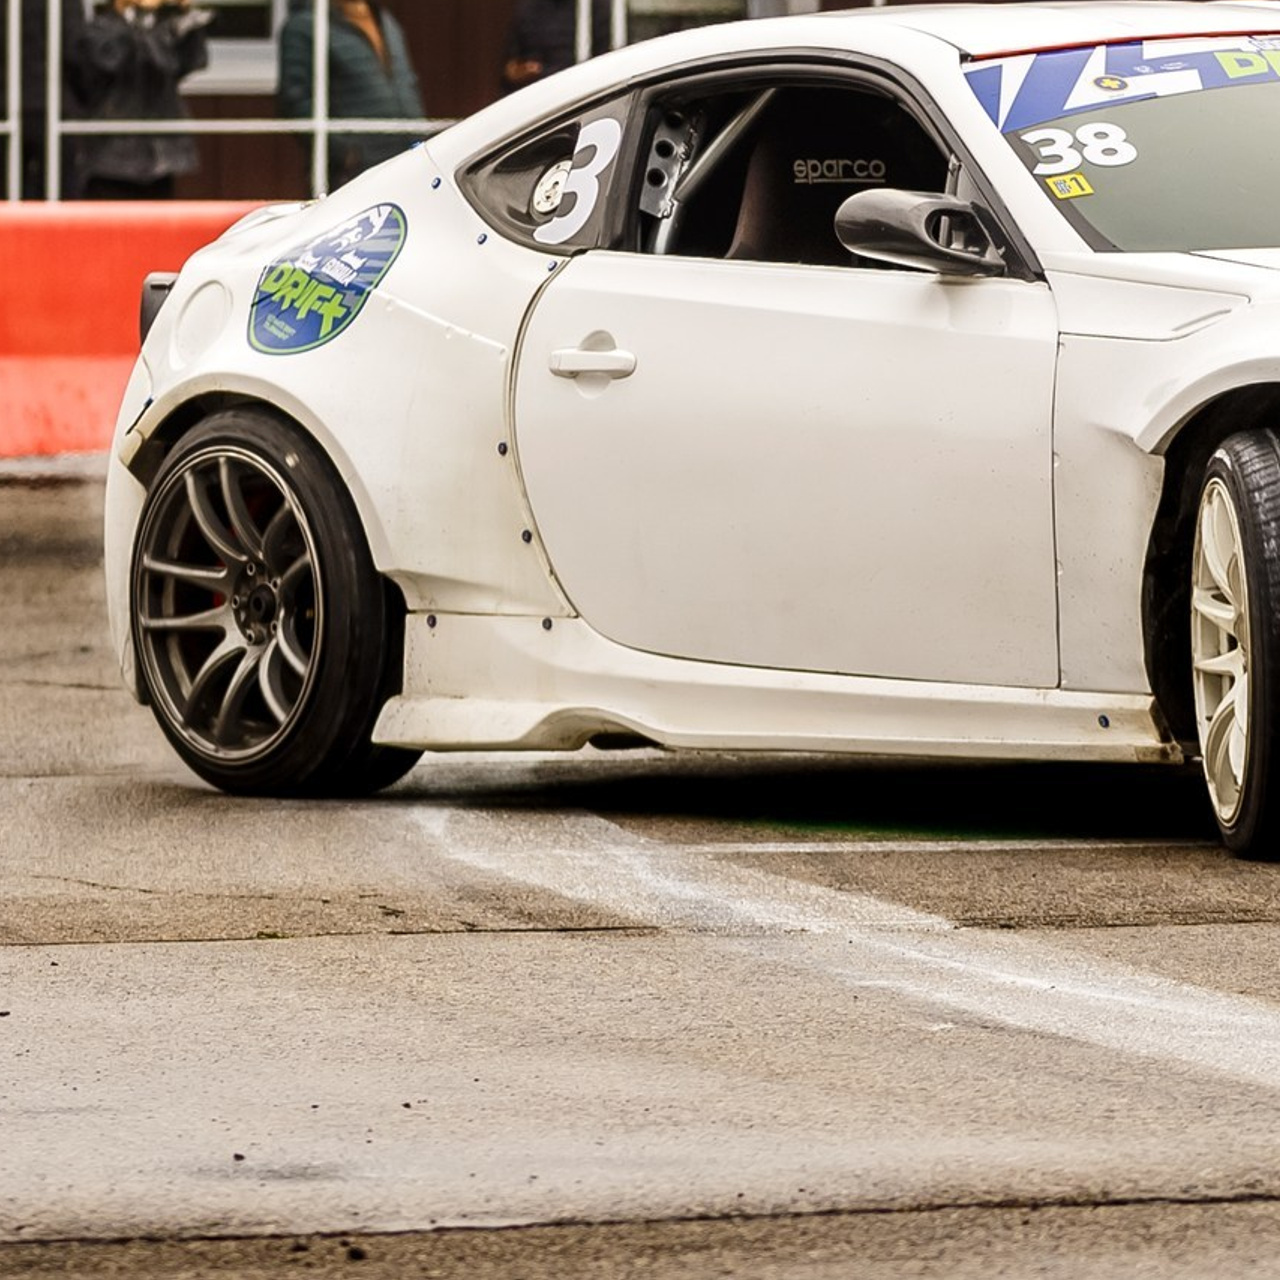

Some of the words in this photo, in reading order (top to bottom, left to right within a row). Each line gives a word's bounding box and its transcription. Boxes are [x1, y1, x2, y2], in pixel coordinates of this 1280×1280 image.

[794, 159, 886, 184] sparco
[1020, 122, 1138, 175] 38
[259, 261, 348, 339] DRIFT
